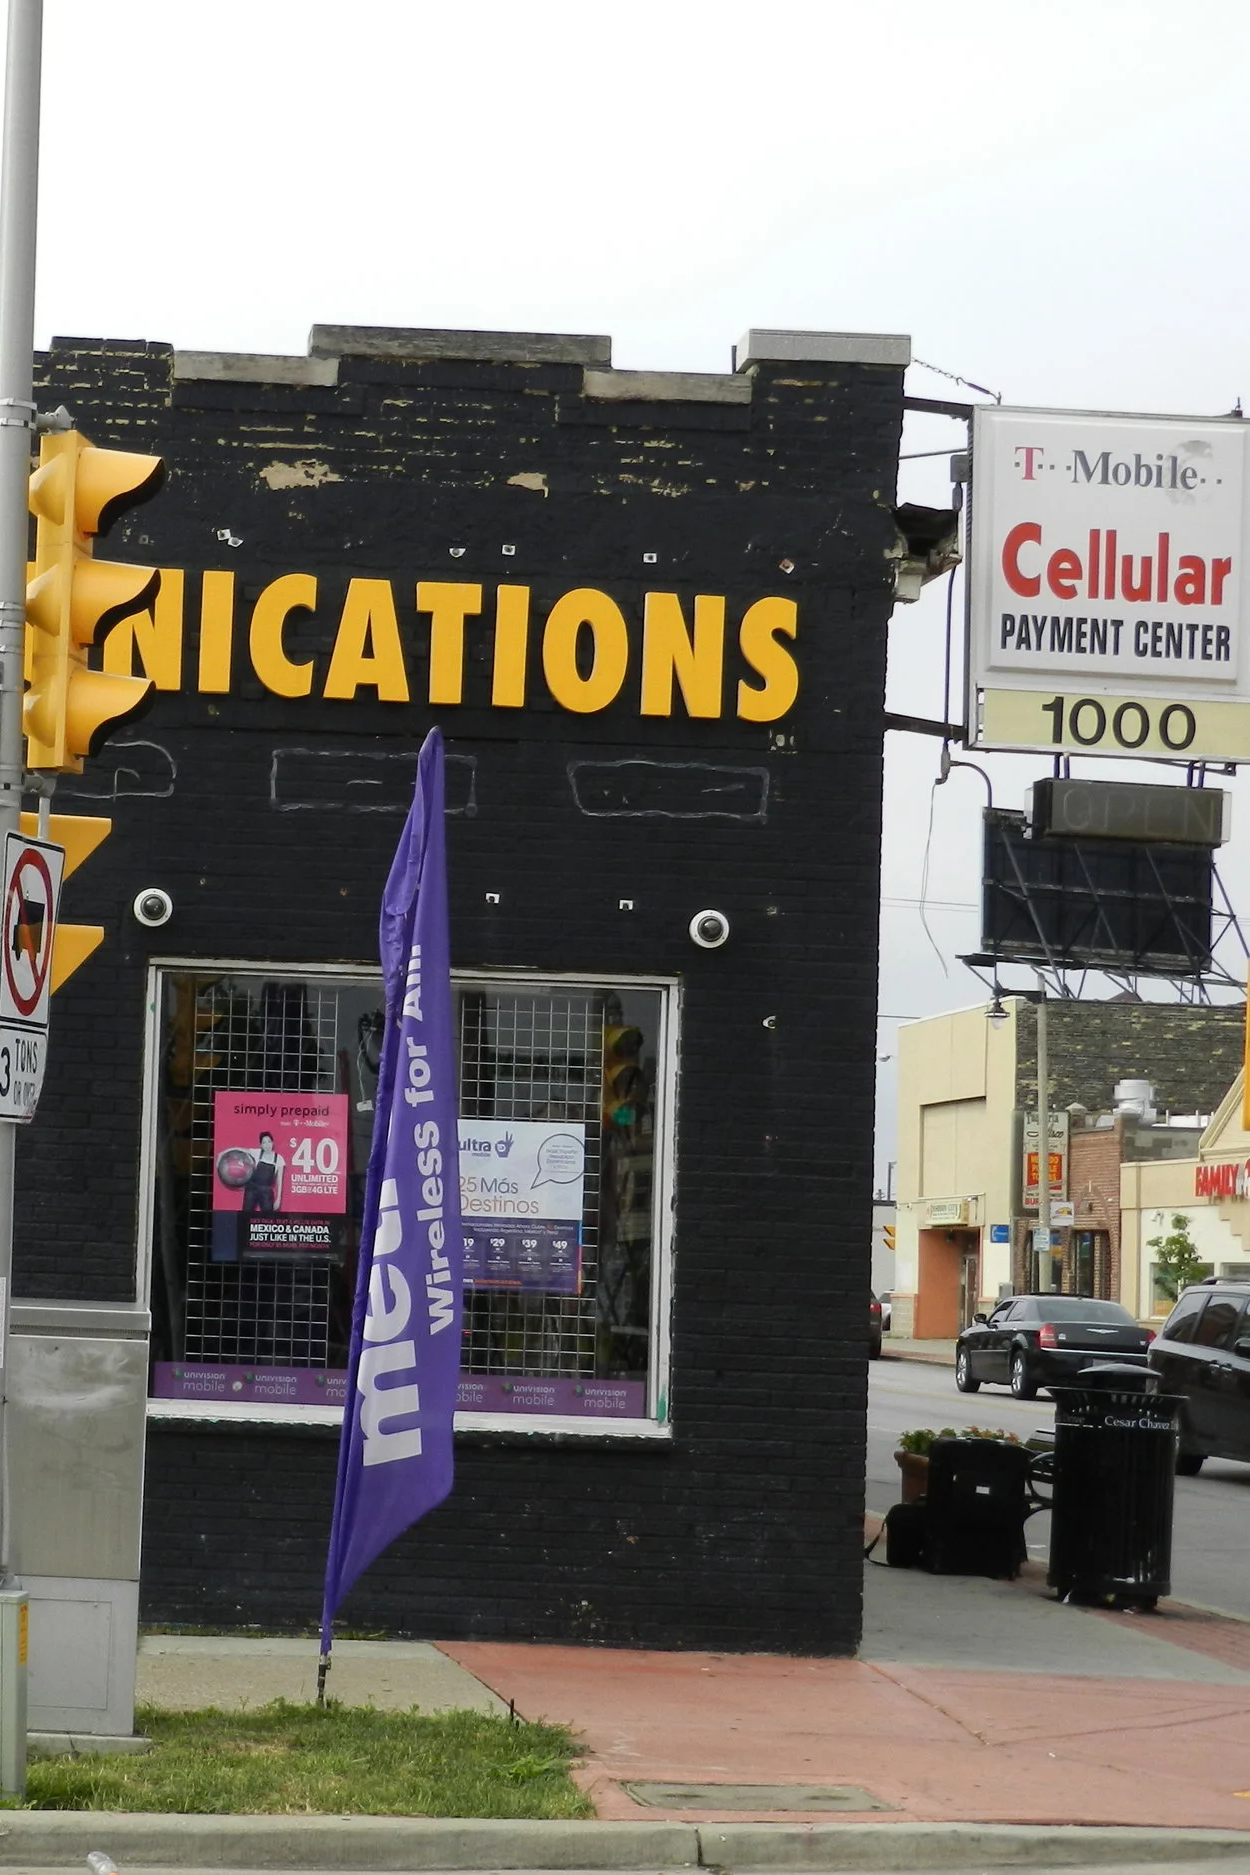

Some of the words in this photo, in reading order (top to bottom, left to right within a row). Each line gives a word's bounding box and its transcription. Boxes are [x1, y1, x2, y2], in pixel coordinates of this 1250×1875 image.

[1002, 521, 1232, 606] Cellular
[1000, 613, 1123, 656] PAYMENT
[1134, 621, 1231, 662] CENTER
[1042, 696, 1197, 751] 1000
[1063, 788, 1215, 838] OPEN
[15, 1038, 38, 1074] TONS
[0, 1047, 10, 1097] 3
[404, 1036, 434, 1107] for
[234, 1104, 277, 1117] simply
[280, 1106, 329, 1118] prepaid
[459, 1138, 491, 1152] ultra
[290, 1137, 339, 1174] $40
[291, 1174, 338, 1183] UNLIMITED
[1196, 1164, 1239, 1197] FAMILY
[291, 1185, 307, 1193] 3GB
[481, 1177, 518, 1194] Más
[250, 1224, 285, 1233] MEXICO
[285, 1225, 292, 1233] &
[292, 1225, 330, 1234] CANADA
[414, 1120, 454, 1335] Wireless
[250, 1233, 269, 1241] JUST
[270, 1233, 287, 1242] LIKE
[289, 1234, 297, 1242] IN
[298, 1234, 315, 1242] THE
[316, 1235, 331, 1243] U.S.
[463, 1238, 474, 1247] 19
[184, 1371, 226, 1380] univision
[255, 1374, 297, 1383] univision
[183, 1381, 225, 1393] mobile
[254, 1383, 296, 1395] mobile
[457, 1382, 484, 1391] vision
[513, 1385, 555, 1394] univision
[585, 1388, 626, 1397] univision
[456, 1391, 483, 1403] obile
[512, 1394, 555, 1406] mobile
[584, 1397, 626, 1409] mobile
[1104, 1415, 1137, 1428] Cesar
[1139, 1417, 1170, 1430] Chavez
